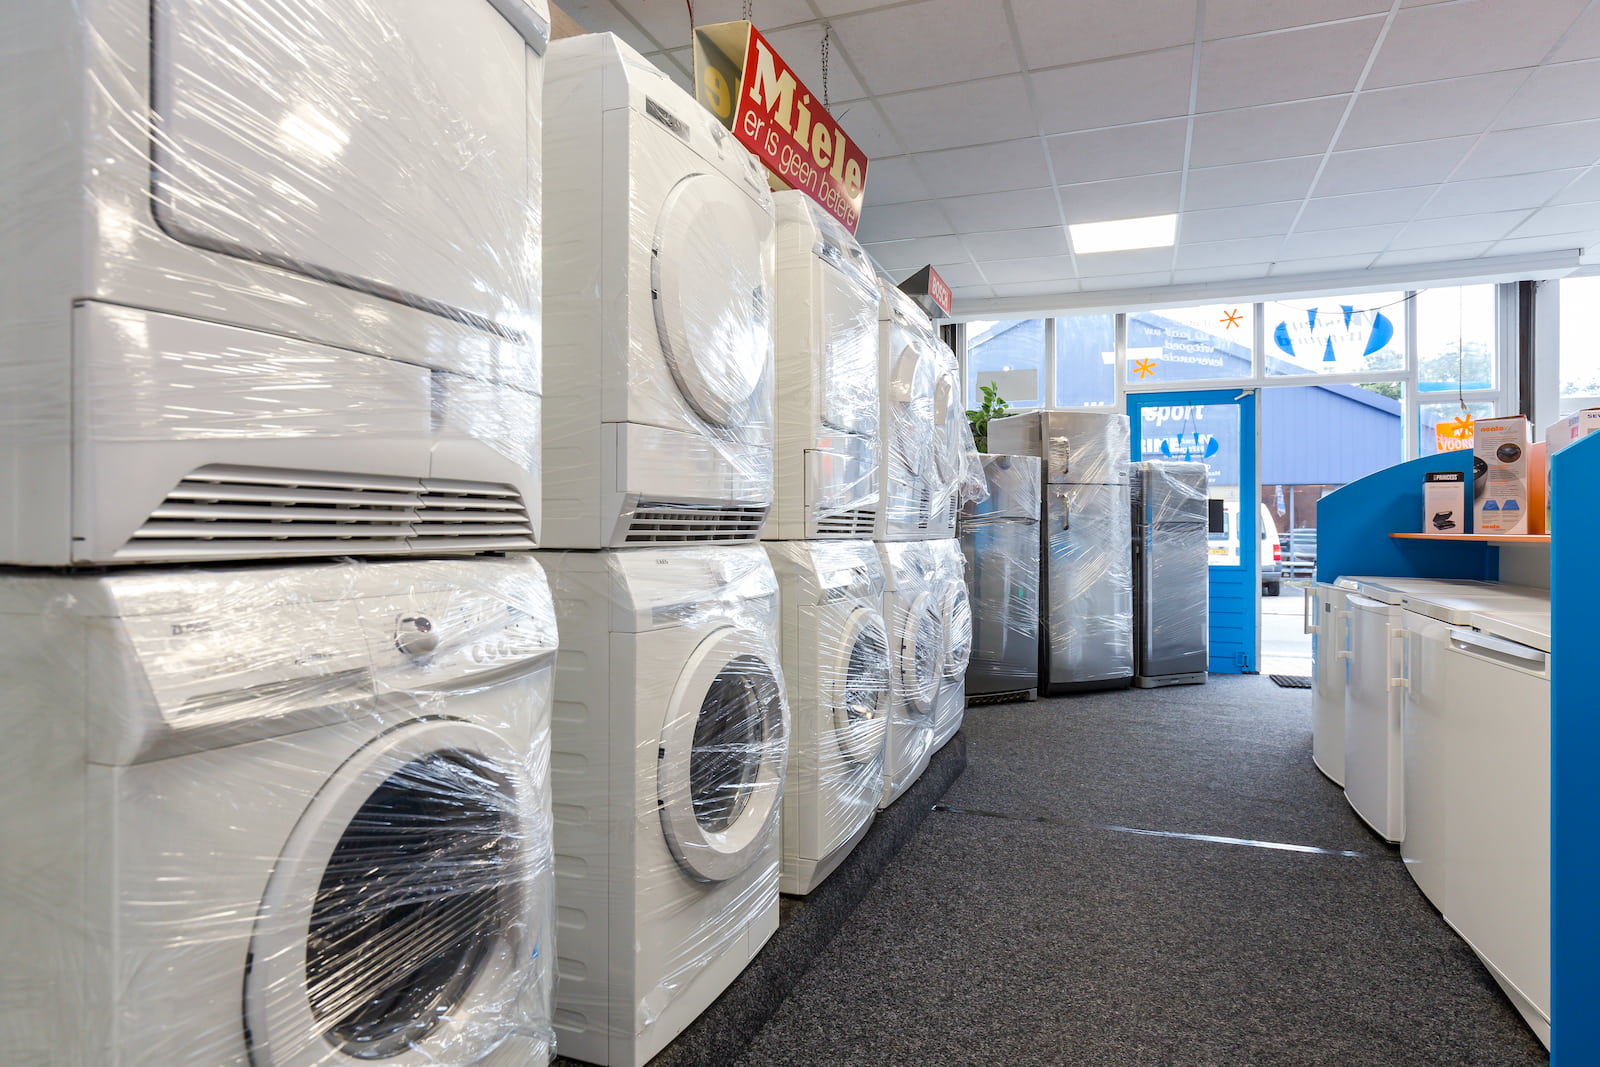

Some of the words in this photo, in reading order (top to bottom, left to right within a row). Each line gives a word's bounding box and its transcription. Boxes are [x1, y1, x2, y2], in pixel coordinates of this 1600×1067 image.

[743, 109, 765, 137] er
[765, 119, 780, 157] is
[779, 143, 818, 195] geen
[818, 171, 856, 227] betere
[749, 38, 862, 200] Miele
[931, 276, 949, 309] BOSCH
